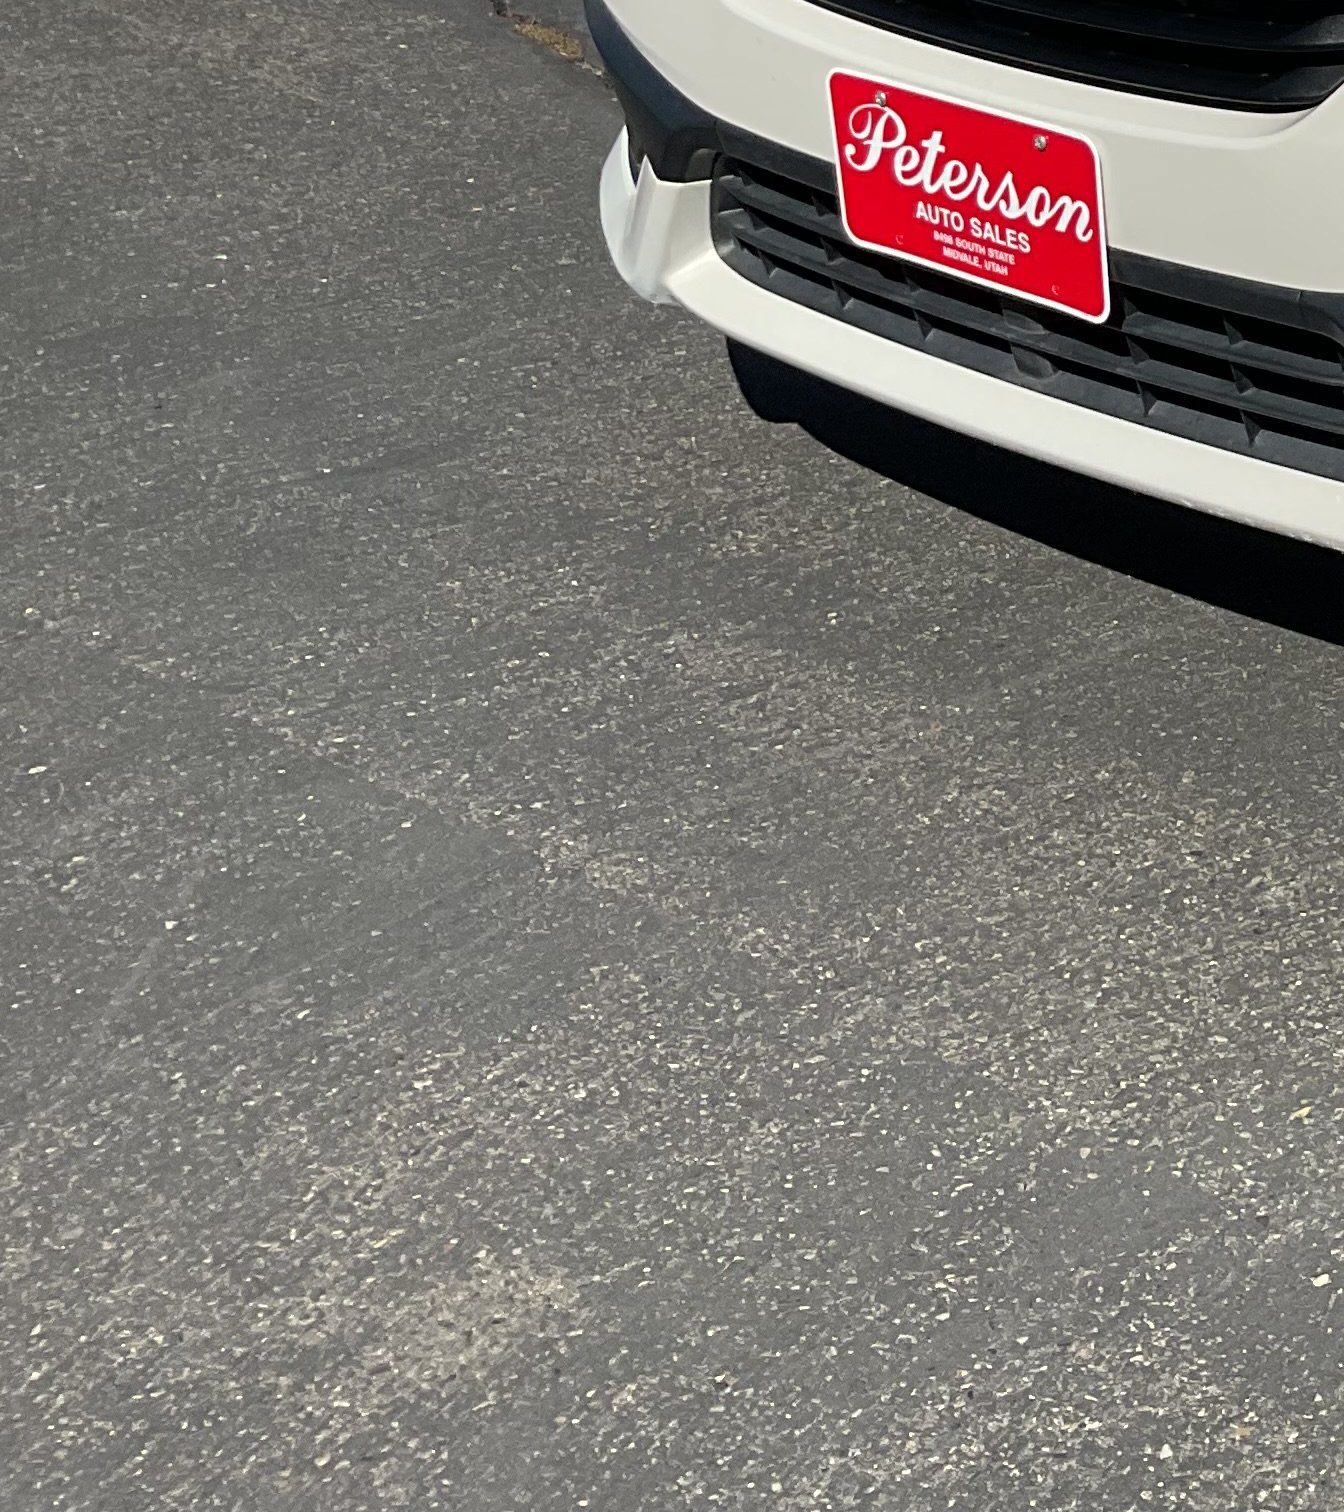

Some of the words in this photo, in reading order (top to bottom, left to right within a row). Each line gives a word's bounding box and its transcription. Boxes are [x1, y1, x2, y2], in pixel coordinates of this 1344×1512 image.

[844, 103, 1093, 243] Peterson
[915, 200, 965, 232] AUTO
[969, 217, 1031, 254] SALES
[954, 236, 986, 256] SOUTH
[987, 247, 1016, 266] STATE
[983, 259, 1009, 277] UTAH
